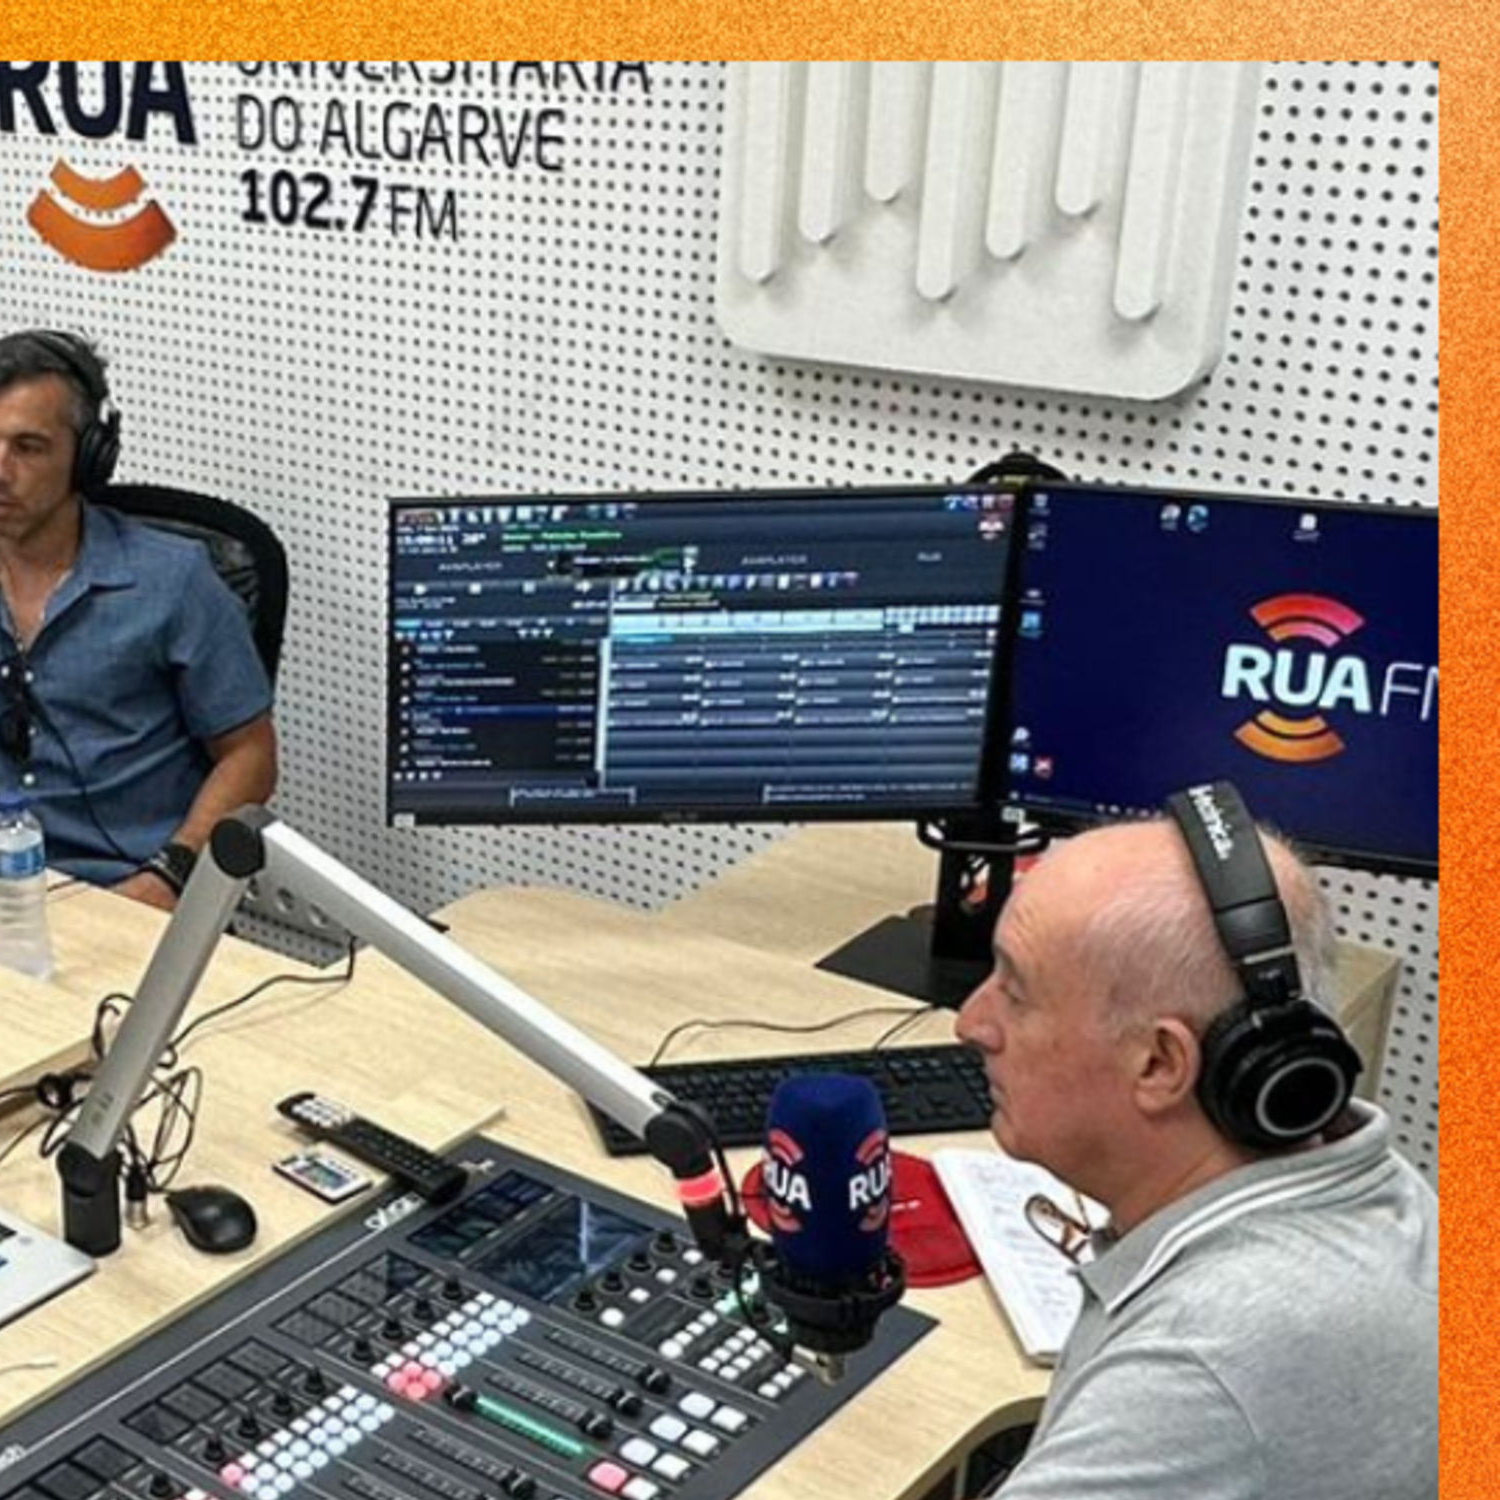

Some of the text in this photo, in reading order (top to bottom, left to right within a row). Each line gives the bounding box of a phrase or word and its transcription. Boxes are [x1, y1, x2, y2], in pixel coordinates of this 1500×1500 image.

[237, 94, 566, 171] DO ALGARVE
[240, 168, 458, 242] 102.7 FM
[1221, 643, 1372, 713] RUA
